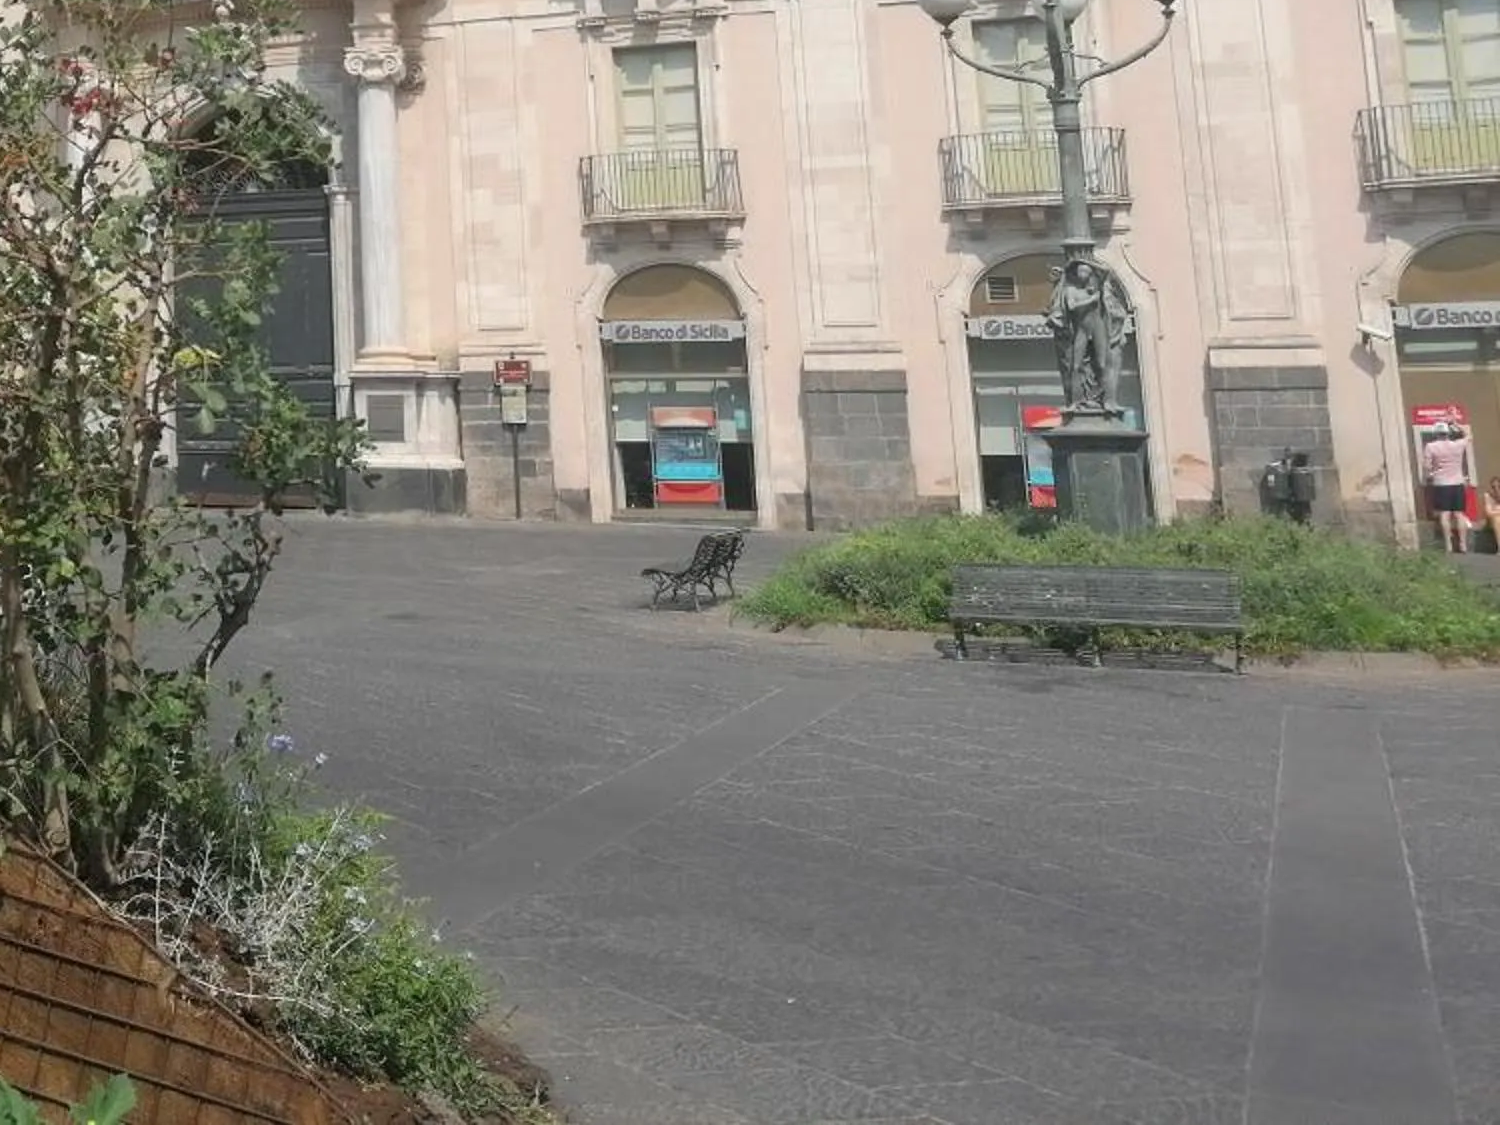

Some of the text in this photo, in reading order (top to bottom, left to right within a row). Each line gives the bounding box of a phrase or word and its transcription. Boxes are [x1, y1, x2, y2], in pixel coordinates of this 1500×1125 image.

[1436, 308, 1492, 325] Banco
[631, 325, 675, 340] Banco
[689, 323, 729, 340] Sicilia
[1002, 320, 1053, 336] Banco
